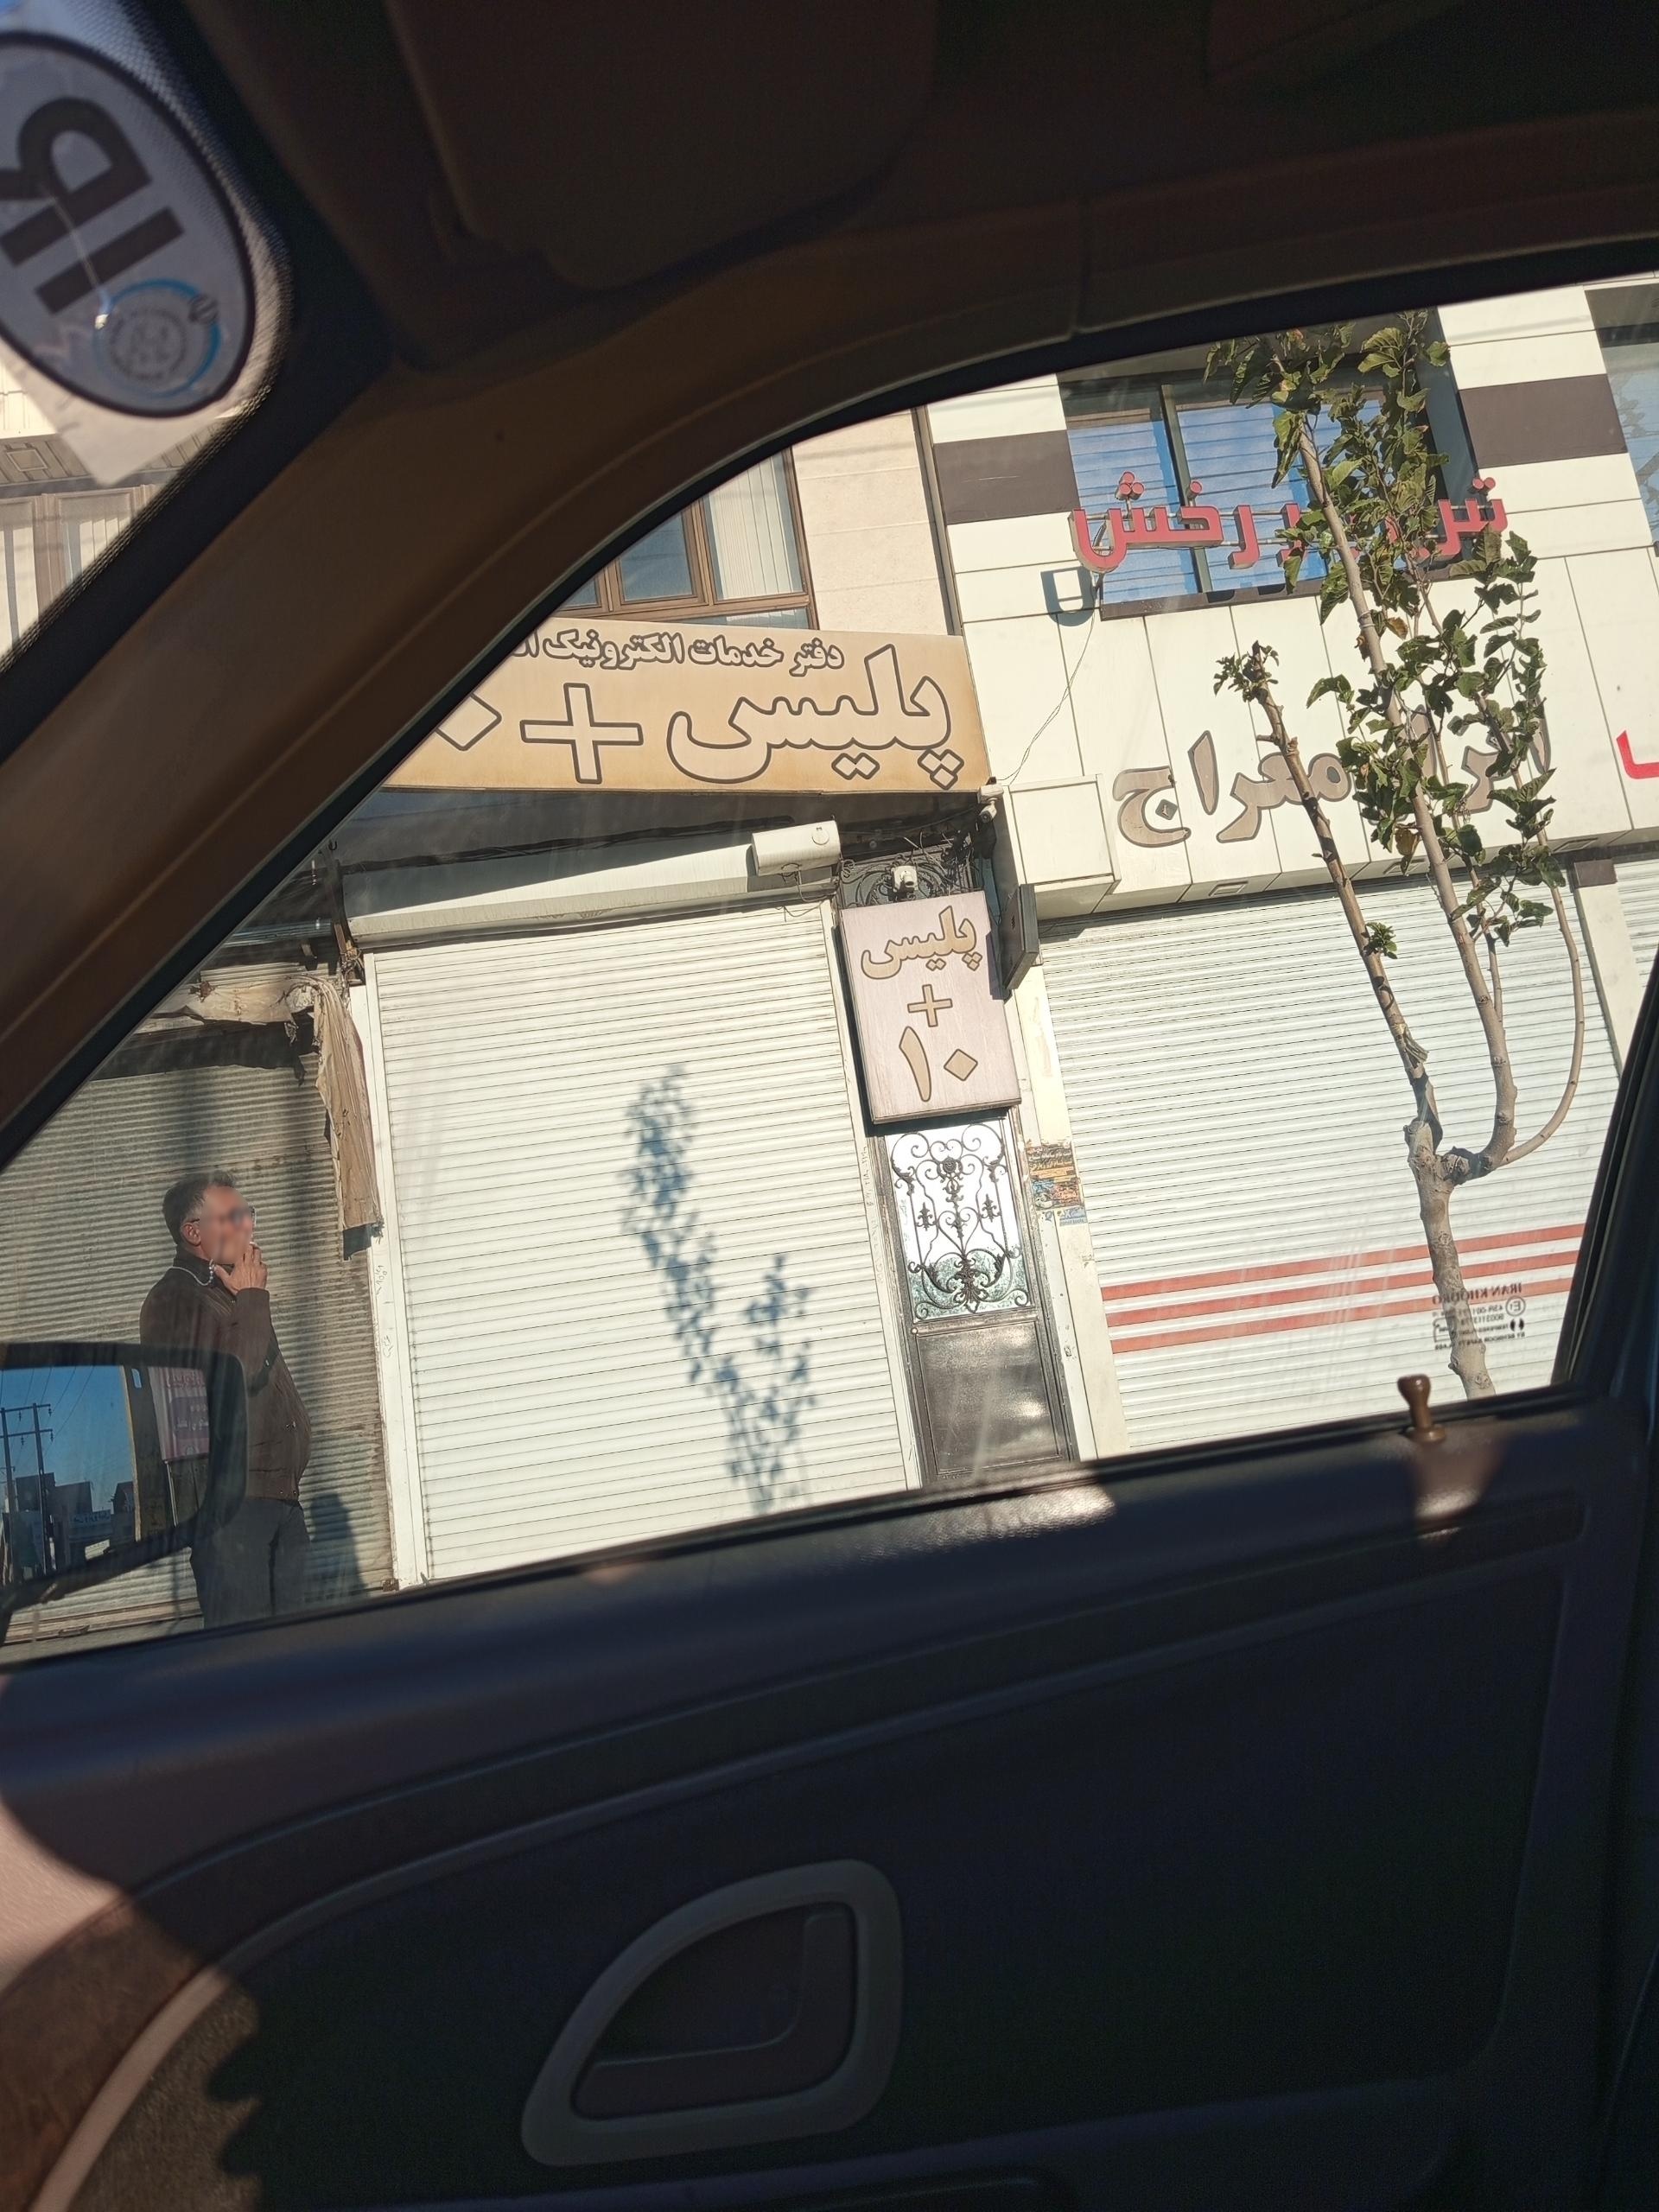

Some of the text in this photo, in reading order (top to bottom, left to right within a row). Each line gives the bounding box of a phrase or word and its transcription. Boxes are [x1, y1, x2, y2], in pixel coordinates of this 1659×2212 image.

[542, 629, 685, 671] الکترونیک
[688, 634, 784, 667] خدمات
[788, 637, 845, 677] دفتر
[519, 683, 644, 784] +
[666, 643, 964, 790] پلیس
[1112, 730, 1351, 848] معراج
[861, 905, 982, 980] پلیس
[907, 983, 953, 1027] +
[899, 1026, 978, 1102] ۱۰
